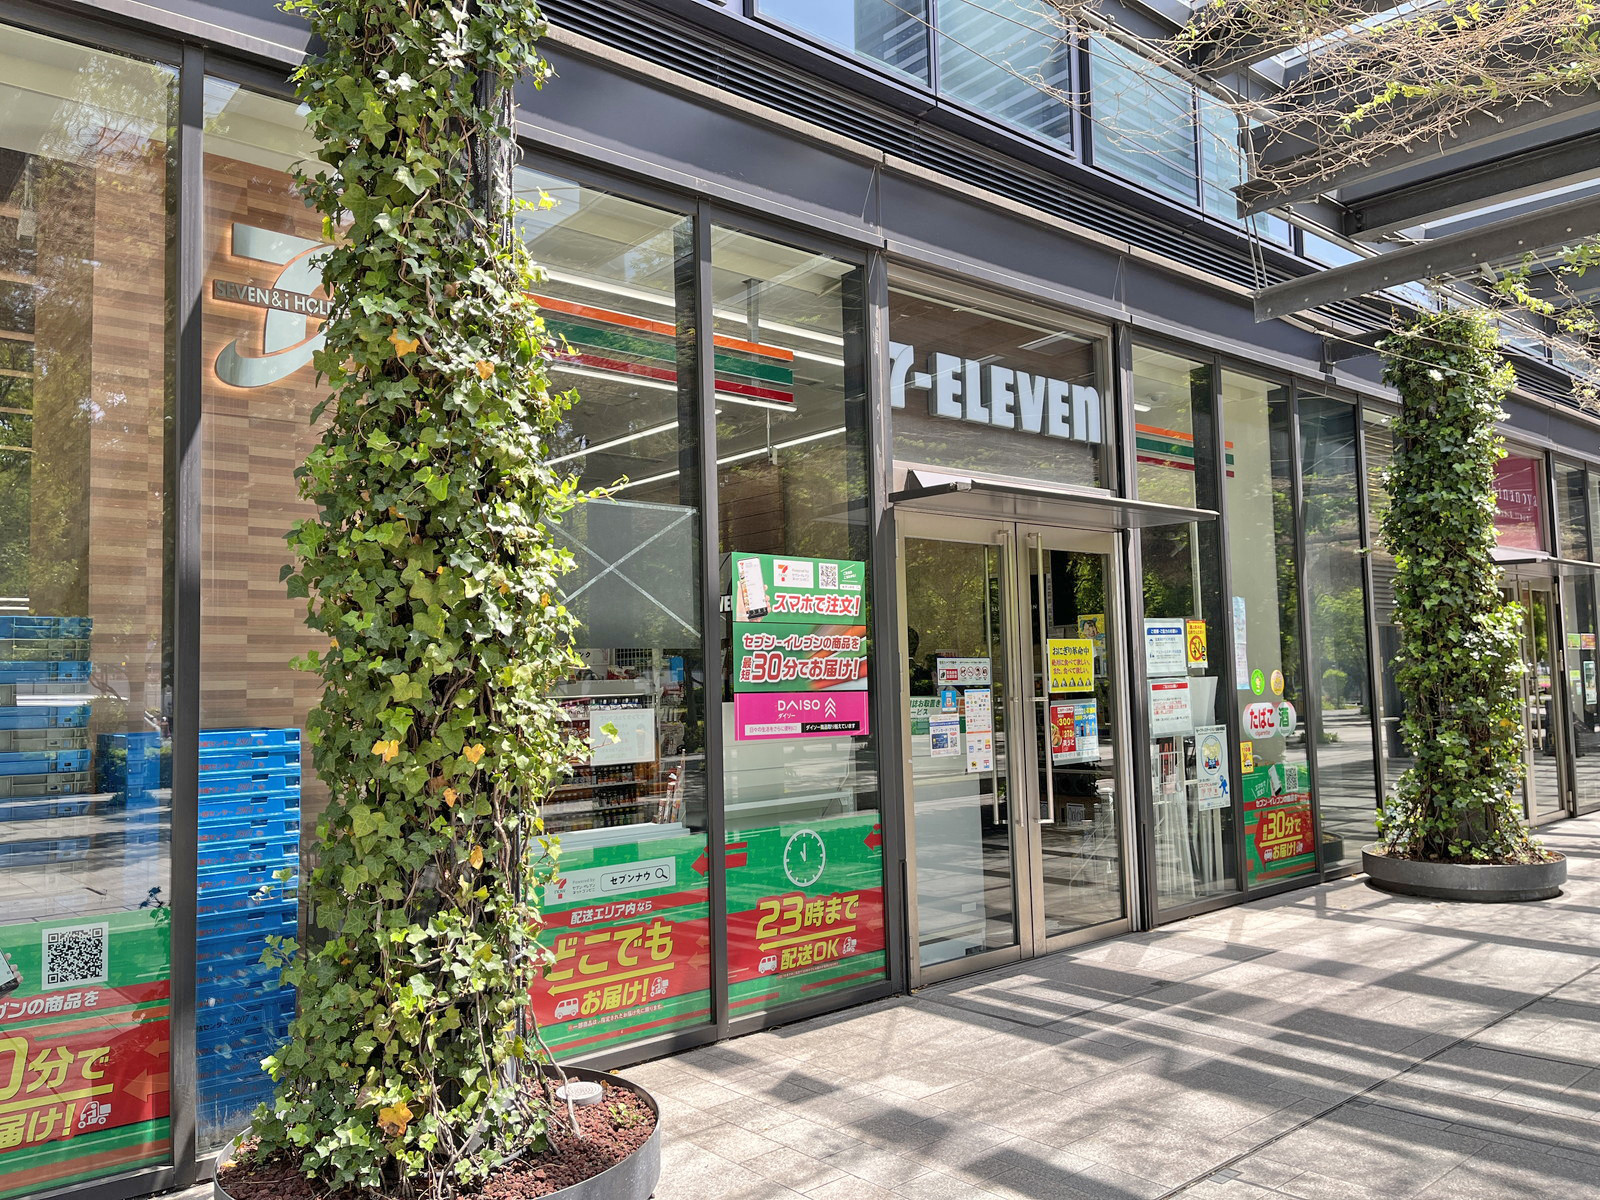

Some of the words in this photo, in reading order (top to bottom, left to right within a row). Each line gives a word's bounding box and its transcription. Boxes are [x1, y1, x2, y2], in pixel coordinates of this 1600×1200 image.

[773, 593, 861, 615] スマホで注文!
[777, 699, 820, 711] DAISO
[1250, 707, 1275, 730] たばこ
[1279, 707, 1290, 728] 酒
[610, 871, 650, 886] セブンナウ
[571, 900, 652, 925] 配送エリア内なら
[755, 894, 860, 940] 23時まで
[544, 921, 673, 982] どこでも
[780, 937, 840, 971] 配送OK
[581, 978, 649, 1016] お届け!
